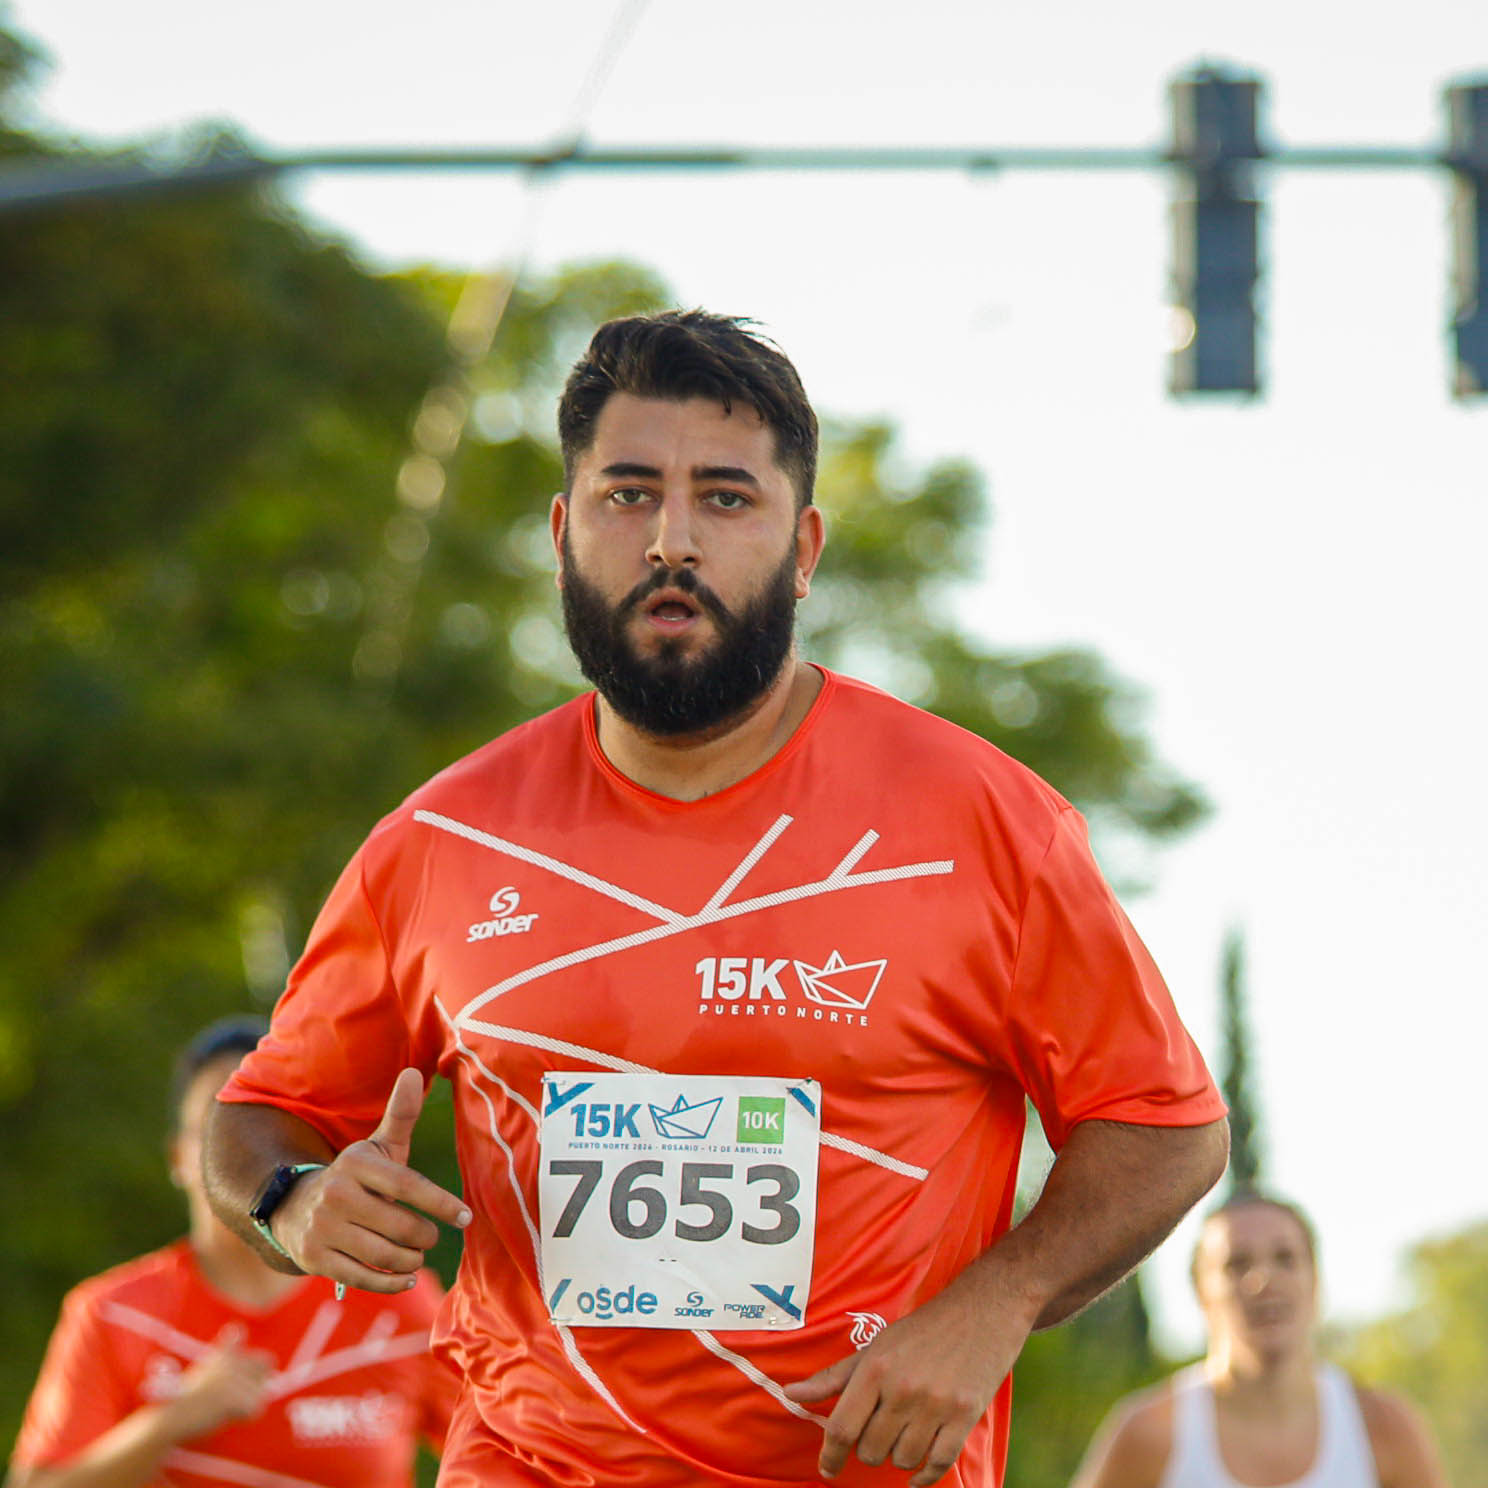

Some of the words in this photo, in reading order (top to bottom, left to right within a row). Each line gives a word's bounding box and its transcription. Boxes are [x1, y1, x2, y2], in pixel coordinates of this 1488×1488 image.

[695, 957, 790, 1000] 15K
[699, 1004, 787, 1016] PUERTO
[797, 1007, 868, 1026] NORTE
[570, 1103, 641, 1138] 15K
[742, 1110, 779, 1131] 10K
[568, 1142, 601, 1150] PUERTO
[602, 1142, 629, 1150] NORTE
[661, 1143, 698, 1152] ROSARIO
[549, 1160, 801, 1245] 7653
